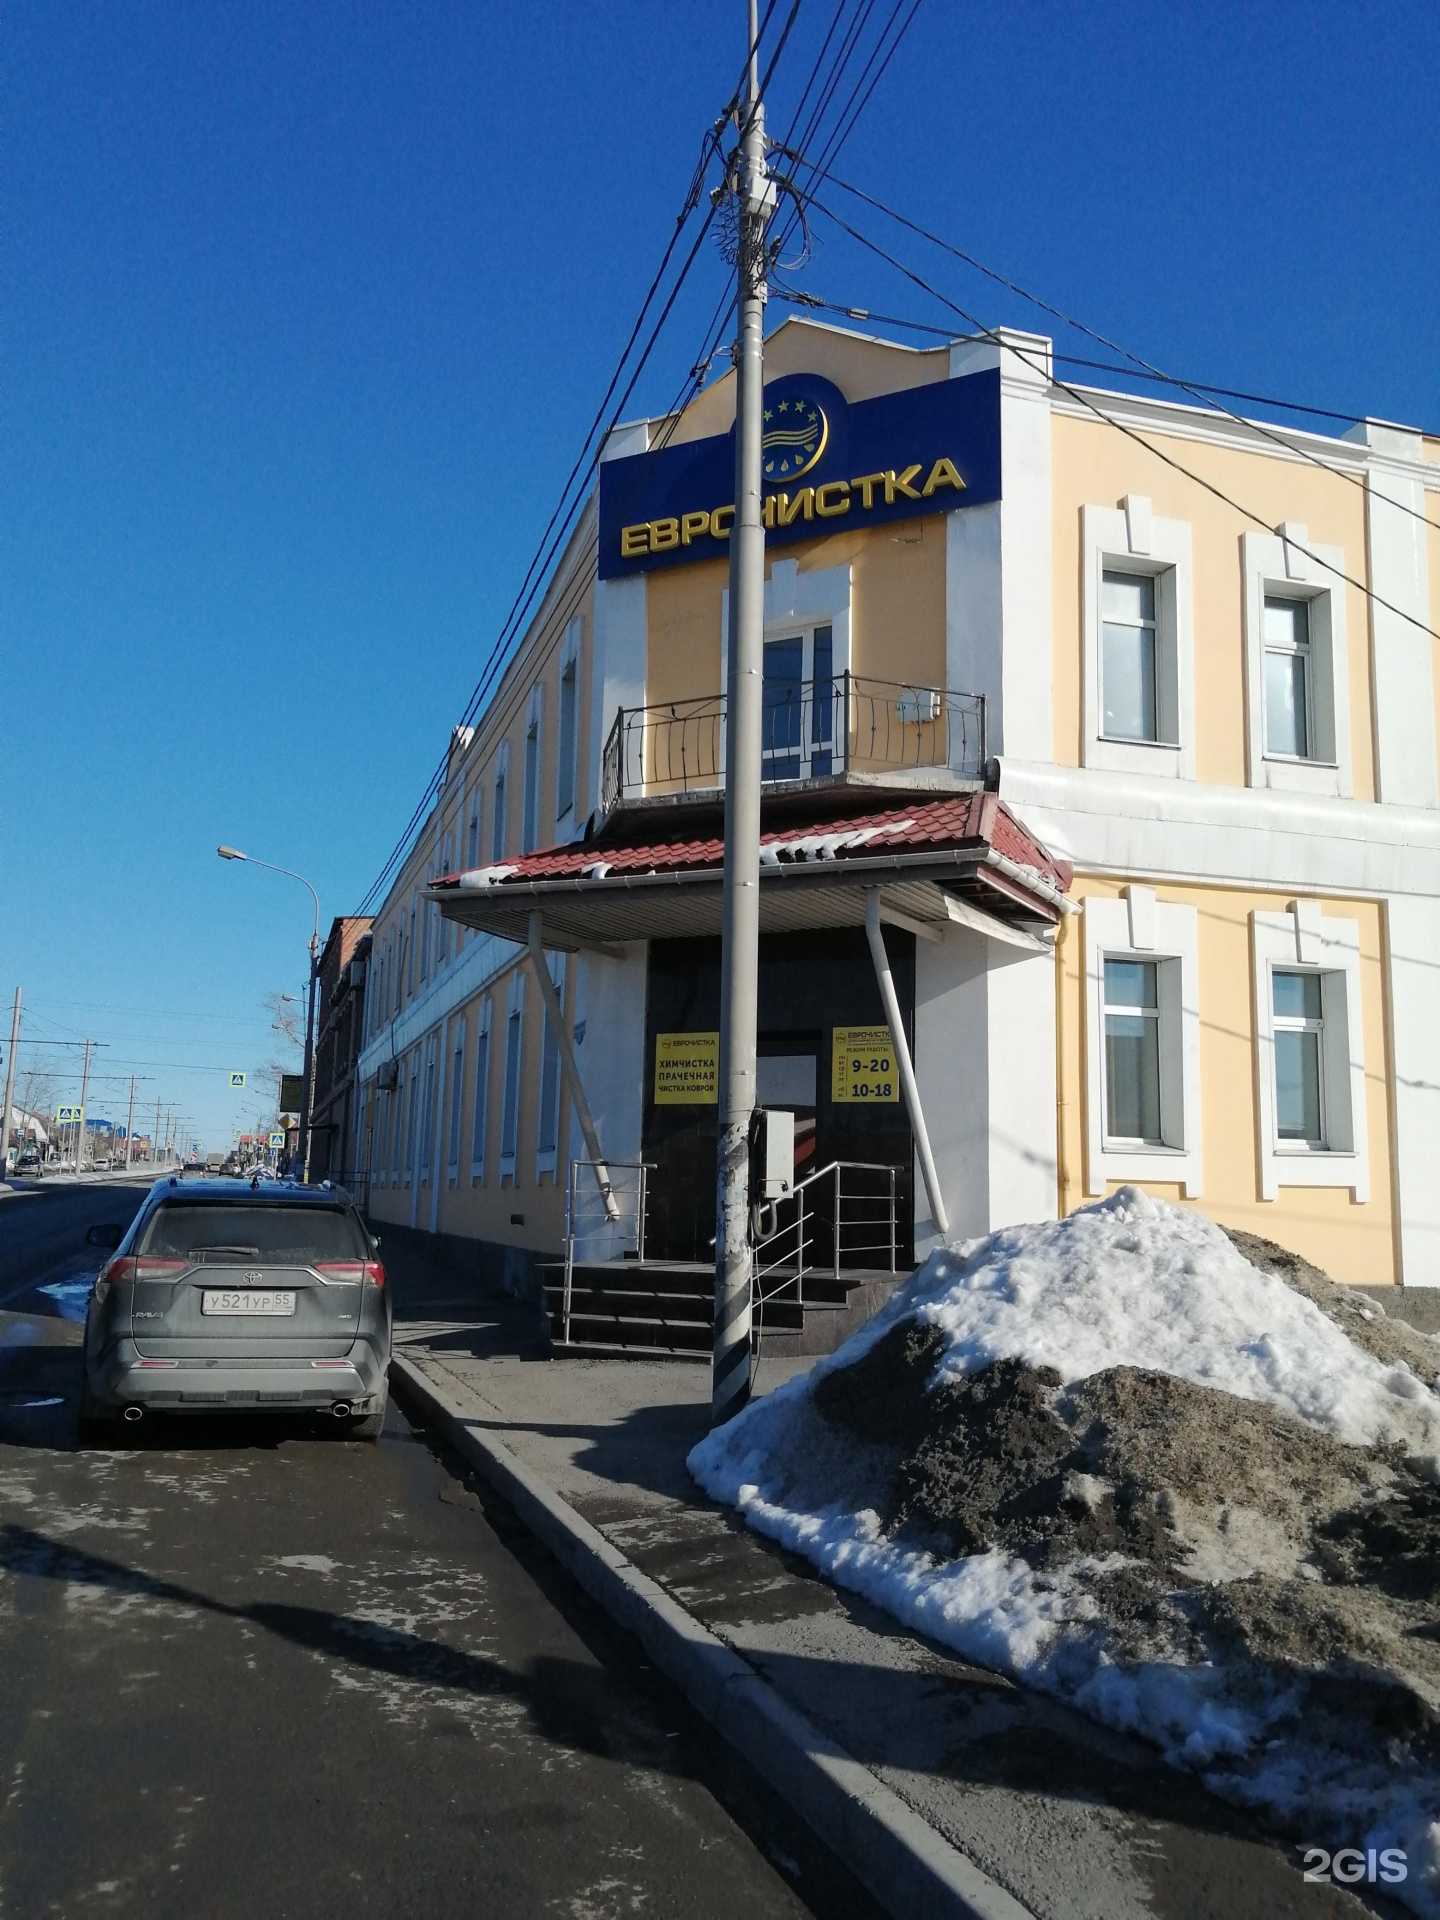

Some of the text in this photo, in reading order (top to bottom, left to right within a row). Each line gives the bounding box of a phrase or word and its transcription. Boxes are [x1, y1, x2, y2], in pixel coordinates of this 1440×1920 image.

[659, 1059, 715, 1068] ХИМЧИСТКА
[852, 1059, 890, 1072] 9-20
[658, 1072, 715, 1080] ПРАЧЕЧНАЯ
[687, 1084, 714, 1092] КОВРОВ
[852, 1083, 892, 1096] 10-18
